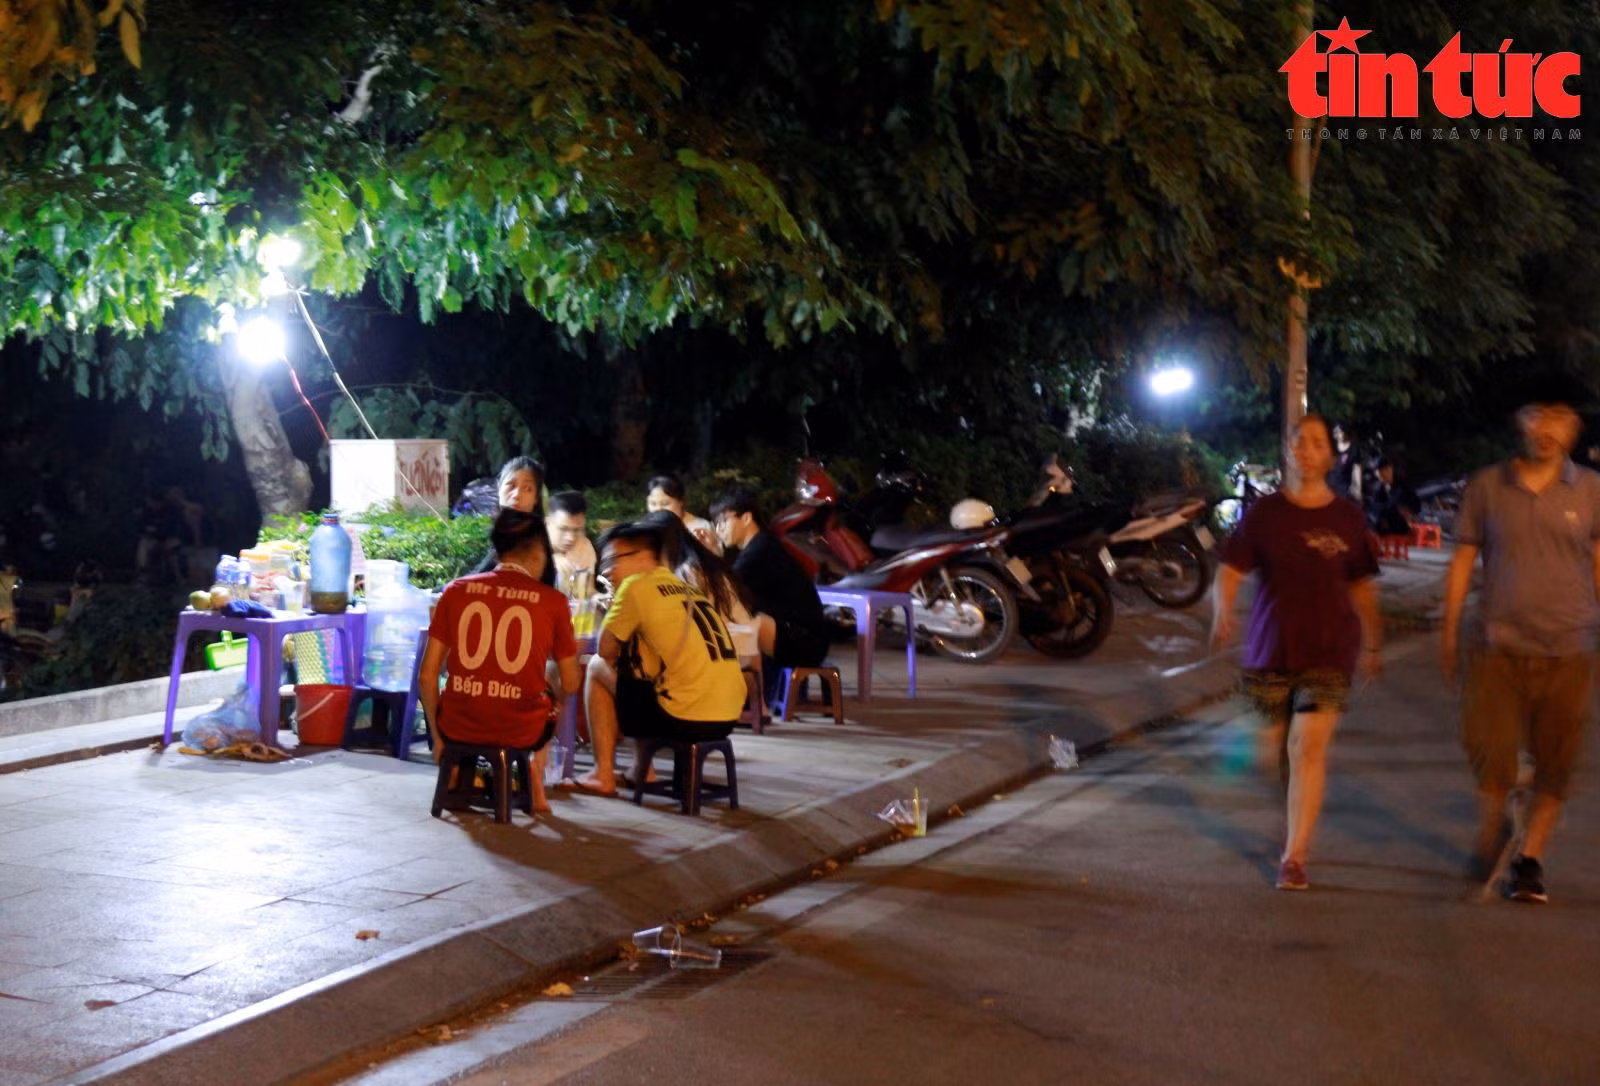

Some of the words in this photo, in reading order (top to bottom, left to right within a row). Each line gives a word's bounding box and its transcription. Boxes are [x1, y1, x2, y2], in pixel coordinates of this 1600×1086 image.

[466, 582, 492, 595] Mr
[457, 600, 533, 675] 00
[453, 674, 483, 697] Bếp
[487, 680, 522, 699] Đức
